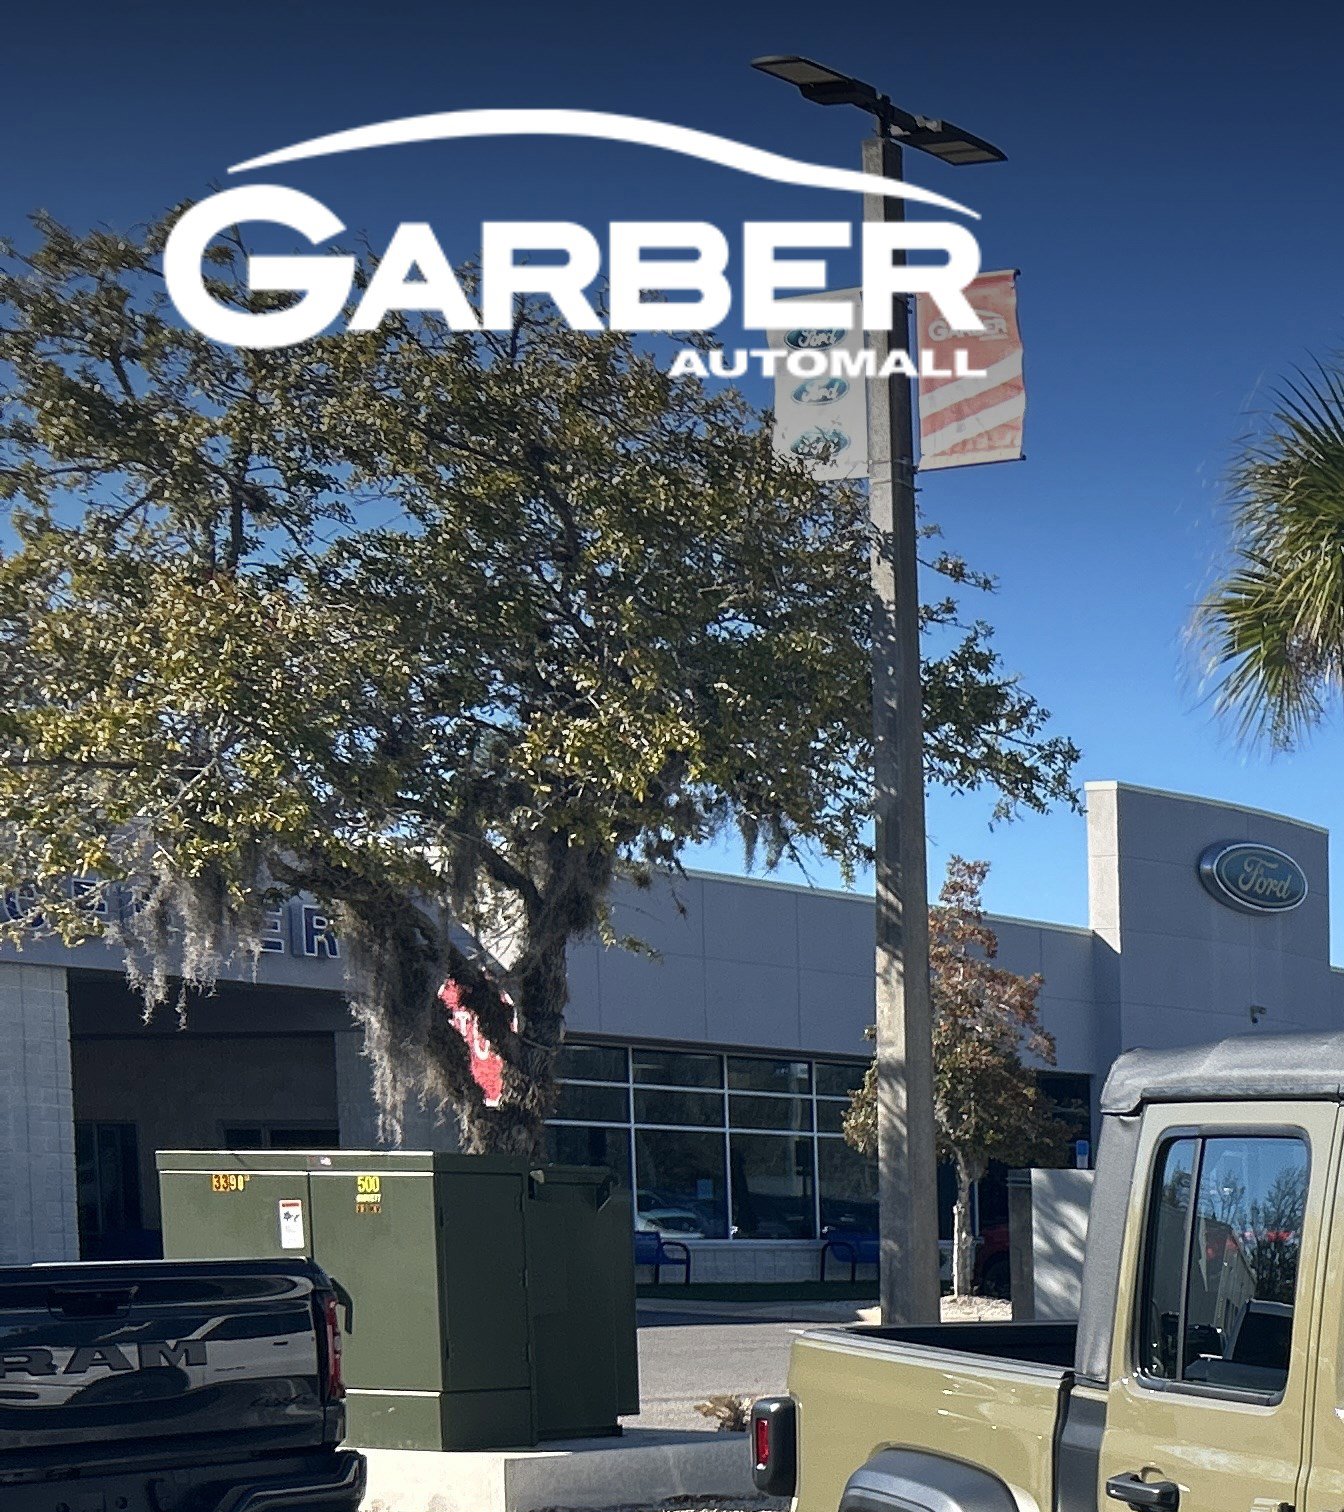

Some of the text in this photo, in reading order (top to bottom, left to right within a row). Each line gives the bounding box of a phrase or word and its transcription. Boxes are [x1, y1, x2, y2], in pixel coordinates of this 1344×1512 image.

[1238, 856, 1292, 899] Ford
[357, 1175, 381, 1193] 500
[0, 1339, 208, 1378] RAM
